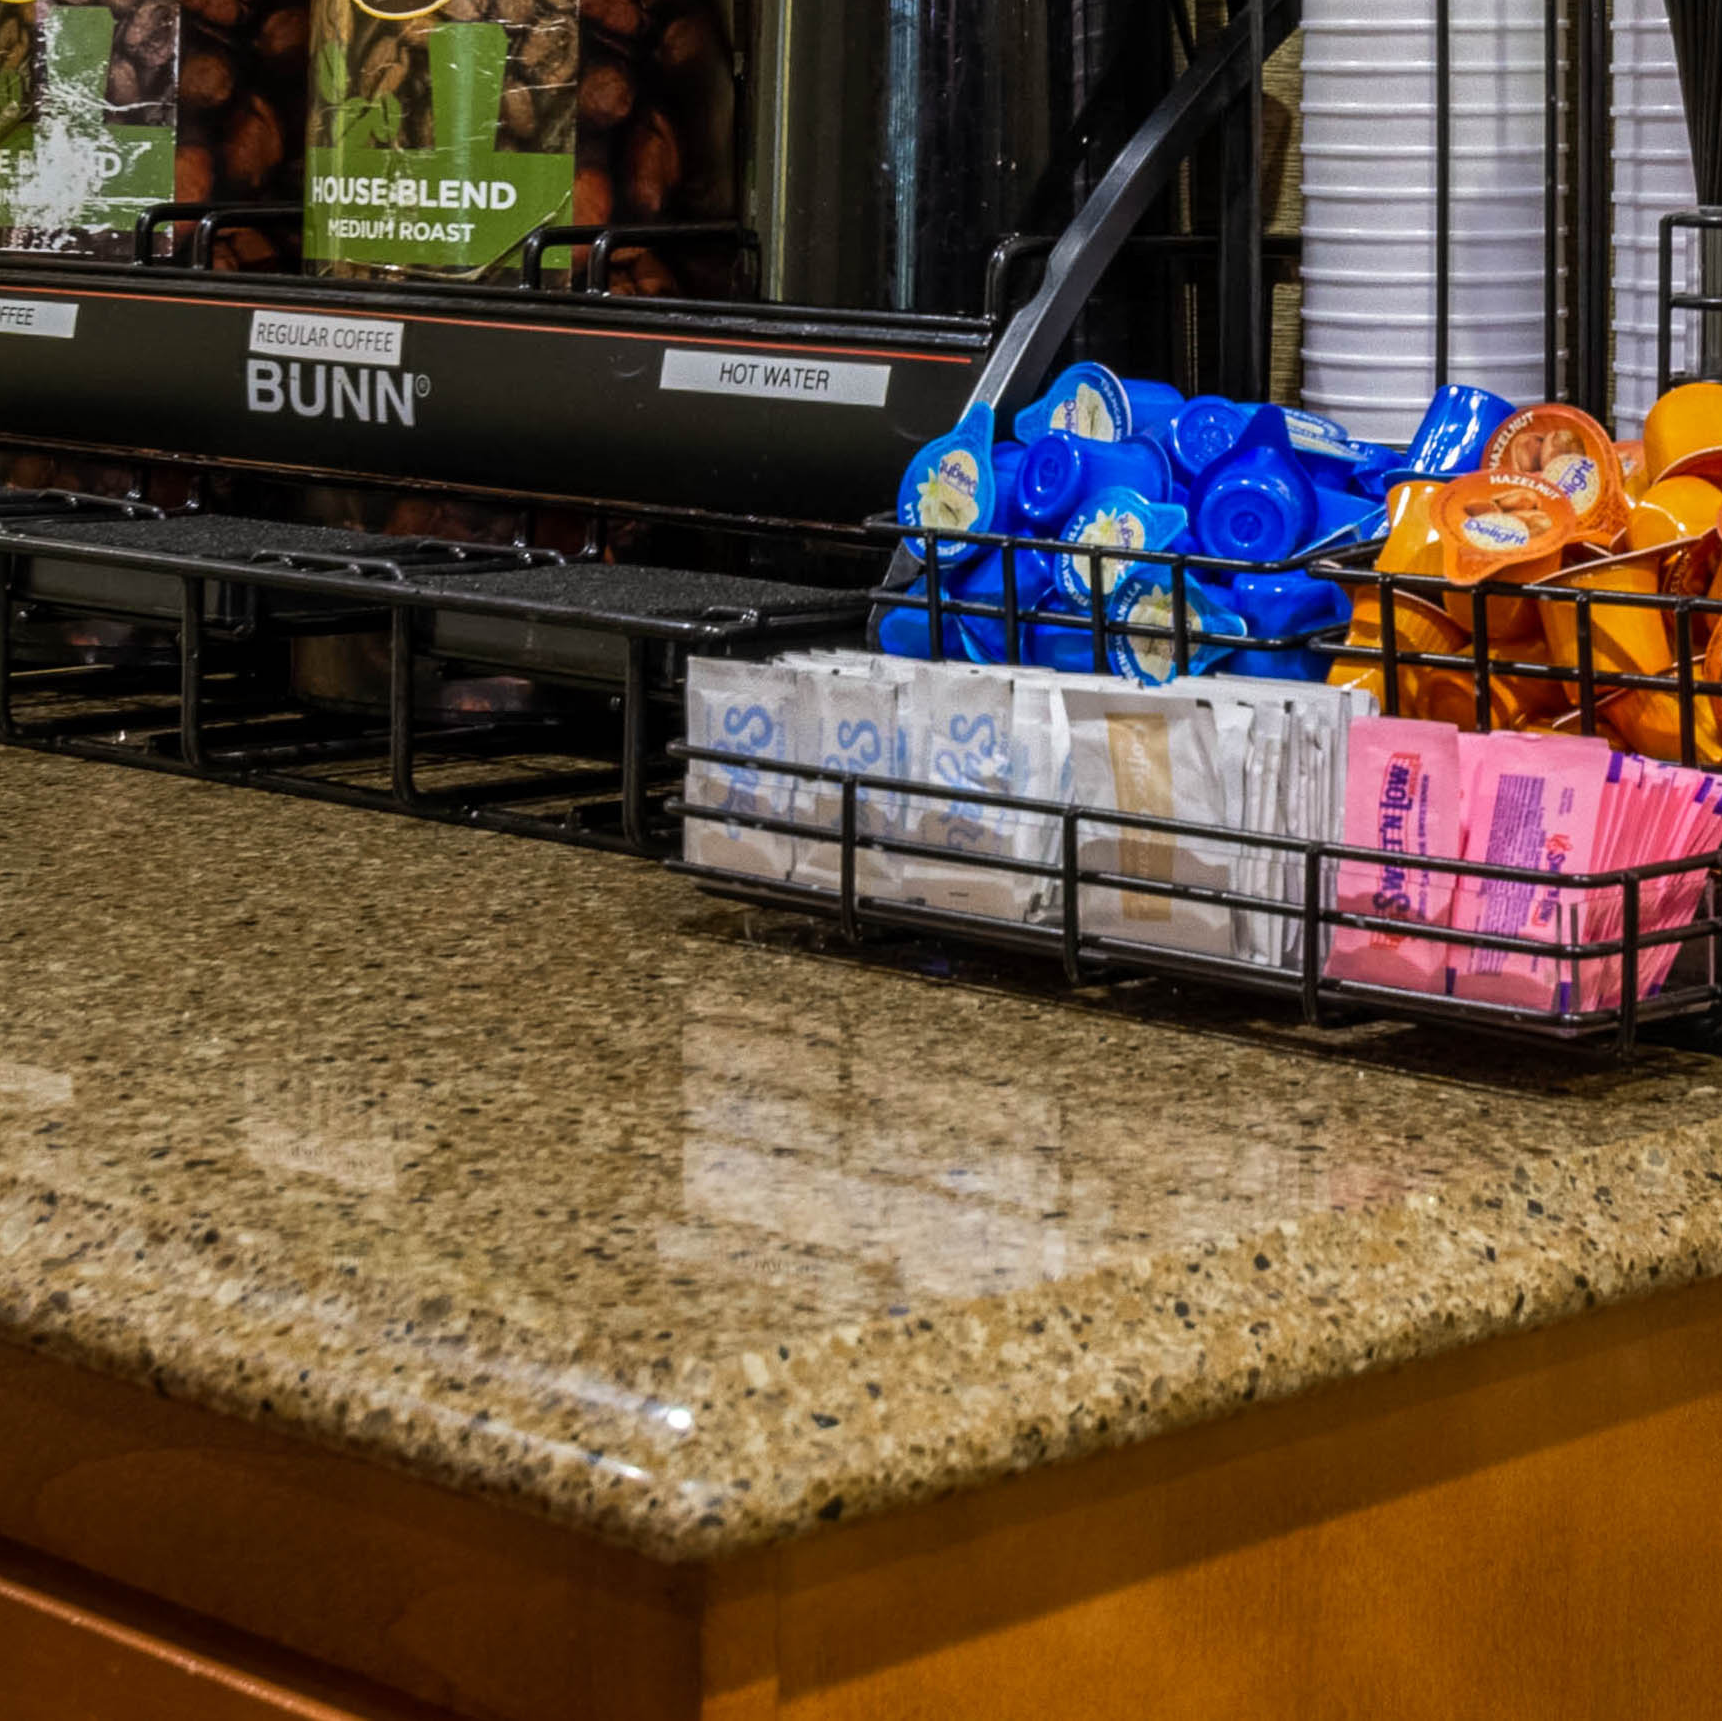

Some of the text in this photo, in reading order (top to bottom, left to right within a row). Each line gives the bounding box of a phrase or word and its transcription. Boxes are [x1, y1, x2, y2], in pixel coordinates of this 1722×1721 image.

[311, 176, 517, 210] HOUSE BLEND
[328, 218, 475, 242] MEDIUM ROAST
[256, 322, 394, 353] REGULAR COFFEE
[719, 361, 830, 391] HOT WATER
[247, 358, 416, 427] BUNN
[1489, 474, 1562, 501] HAZELNUT
[1463, 516, 1528, 547] Delight
